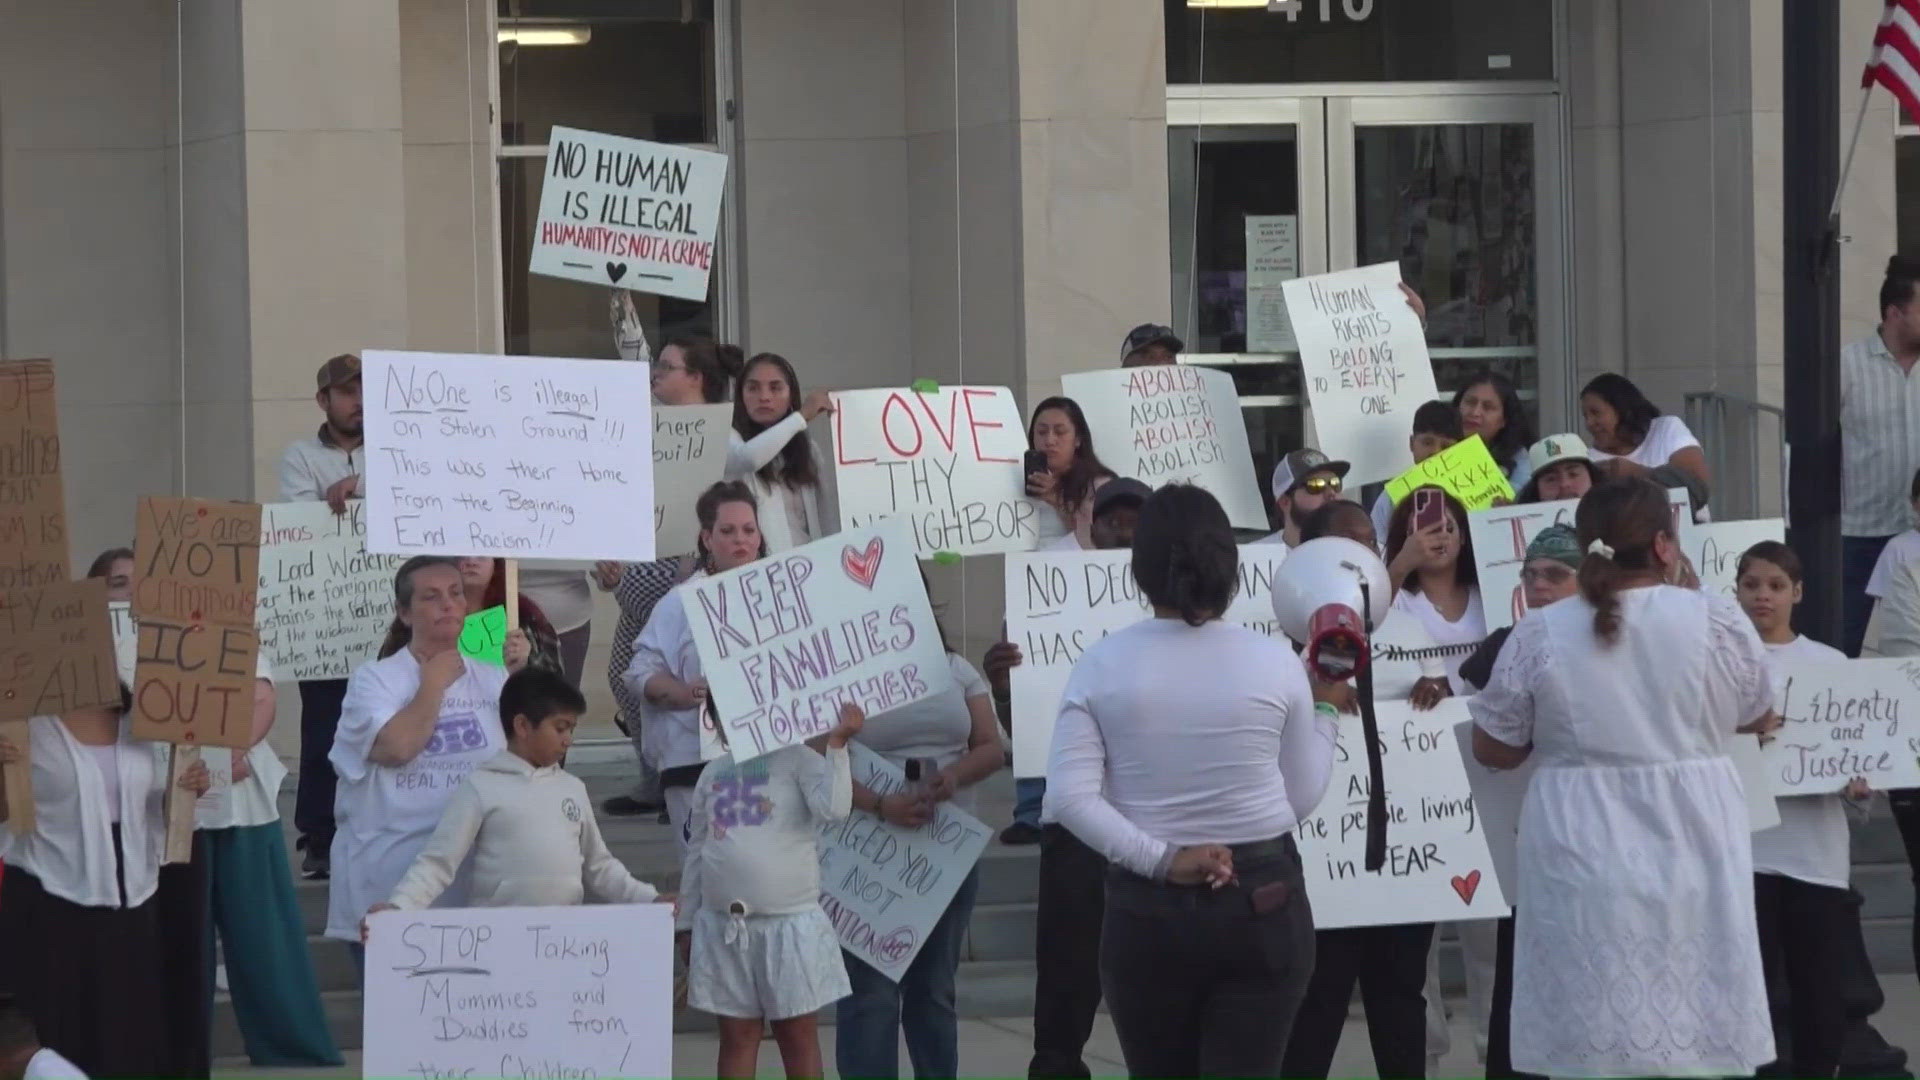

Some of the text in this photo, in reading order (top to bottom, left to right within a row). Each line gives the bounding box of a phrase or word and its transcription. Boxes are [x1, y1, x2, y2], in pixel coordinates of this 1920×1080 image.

[552, 140, 692, 196] NO HUMAN
[562, 190, 698, 236] IS ILLEGAL
[494, 379, 512, 403] is
[1313, 376, 1328, 393] TO
[656, 412, 706, 437] here
[1360, 396, 1392, 415] ONE
[440, 416, 497, 439] Stolen
[521, 416, 589, 443] Ground
[836, 388, 1020, 466] LOVE
[380, 448, 628, 485] This was their Home
[874, 452, 959, 518] THY
[147, 497, 257, 542] We are
[391, 486, 575, 525] From the Beginning
[852, 500, 1036, 552] IGHBOR
[394, 515, 445, 547] End
[146, 539, 261, 583] NOT
[290, 584, 316, 605] the
[1026, 562, 1068, 610] NO
[1084, 562, 1140, 609] DEC
[324, 603, 345, 622] the
[696, 555, 814, 660] KEEP
[137, 620, 252, 676] ICE
[287, 628, 306, 646] the
[315, 641, 338, 658] the
[740, 603, 916, 706] FAMILIES
[293, 655, 350, 679] wicked
[138, 677, 242, 737] OUT
[731, 662, 929, 755] TOGETHER
[1781, 675, 1900, 737] Liberty
[1401, 720, 1444, 752] for
[1831, 722, 1864, 741] and
[395, 772, 463, 790] REAL M
[1782, 741, 1894, 786] Justice
[1341, 804, 1408, 844] pele
[1421, 792, 1475, 834] living
[898, 845, 943, 895] YOU
[1326, 853, 1356, 880] in
[839, 864, 903, 915] NOT
[401, 921, 610, 978] STOP Taking
[572, 983, 606, 1008] and
[433, 1009, 629, 1043] Daddies from
